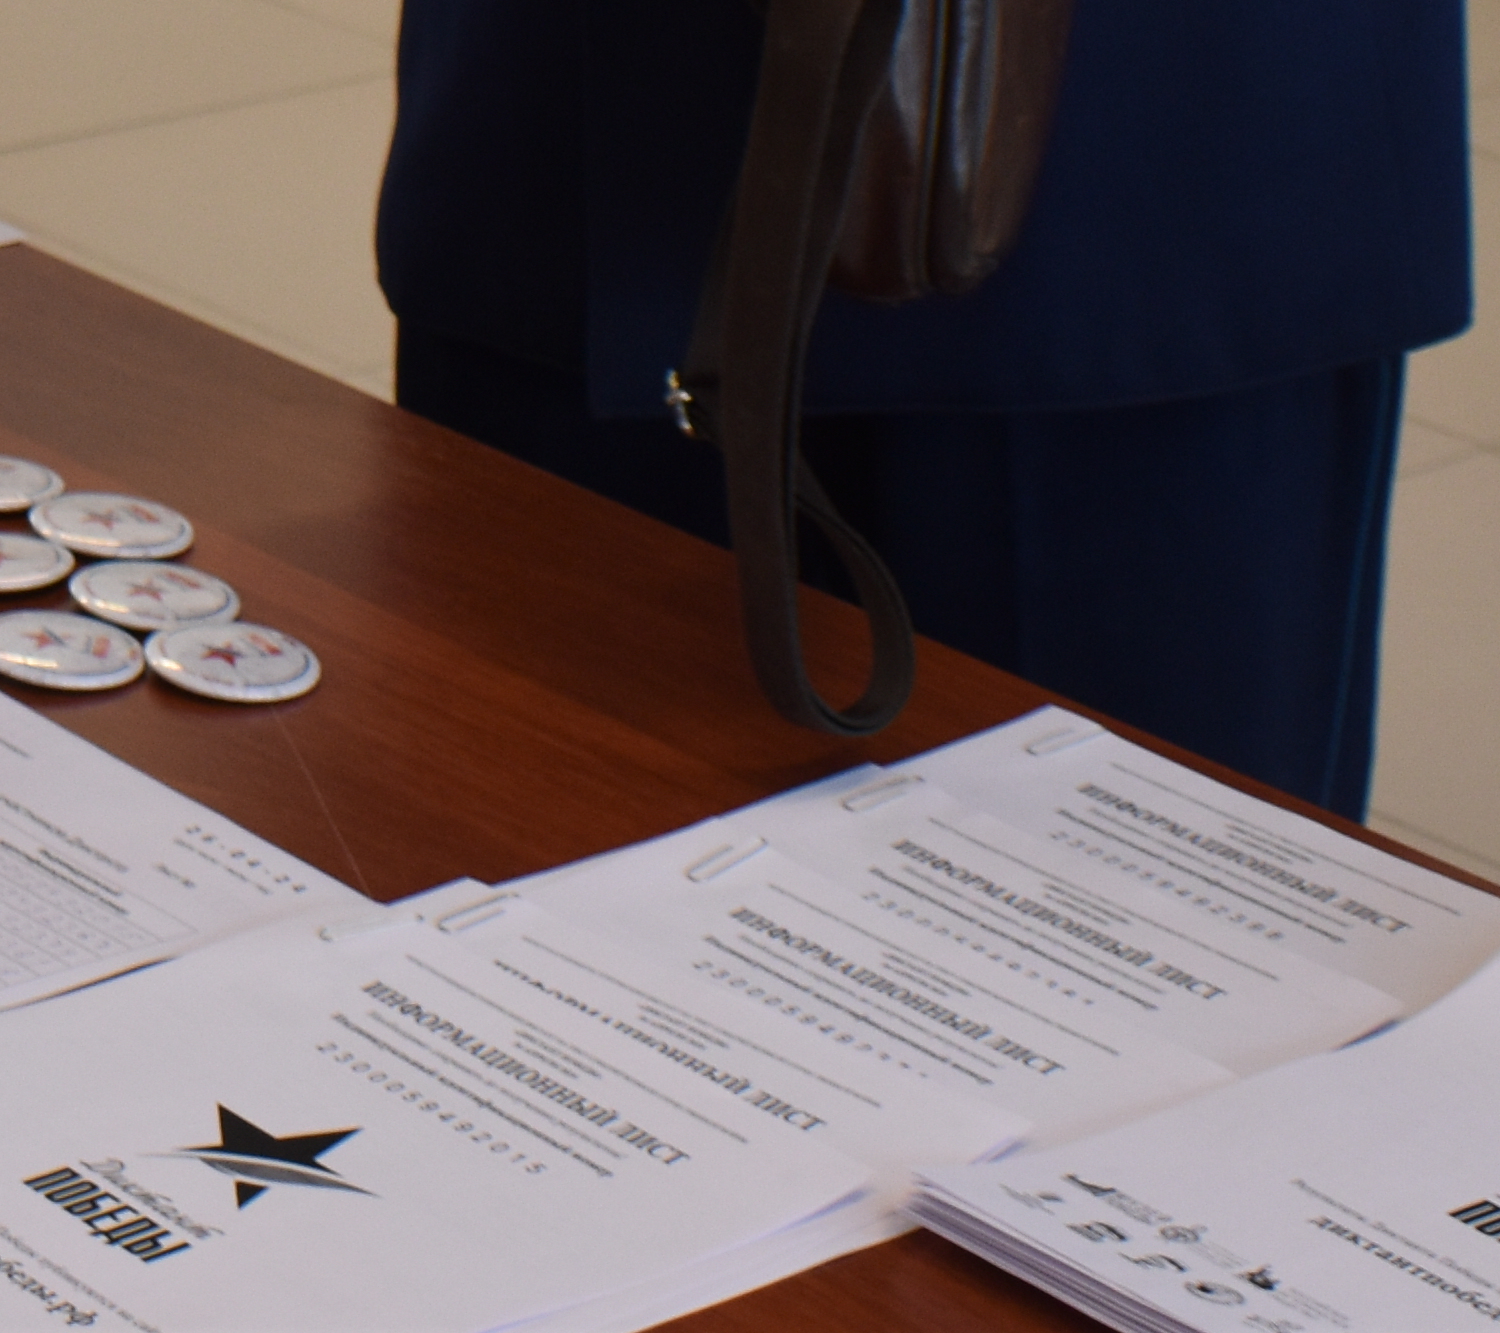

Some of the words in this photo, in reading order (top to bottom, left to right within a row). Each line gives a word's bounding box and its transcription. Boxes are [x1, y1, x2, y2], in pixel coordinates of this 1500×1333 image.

[361, 979, 622, 1129] ИНФОРМАЦИОННЫЙ
[612, 1120, 692, 1166] ЛИСТ
[22, 1164, 193, 1265] ПОБЕДЫ
